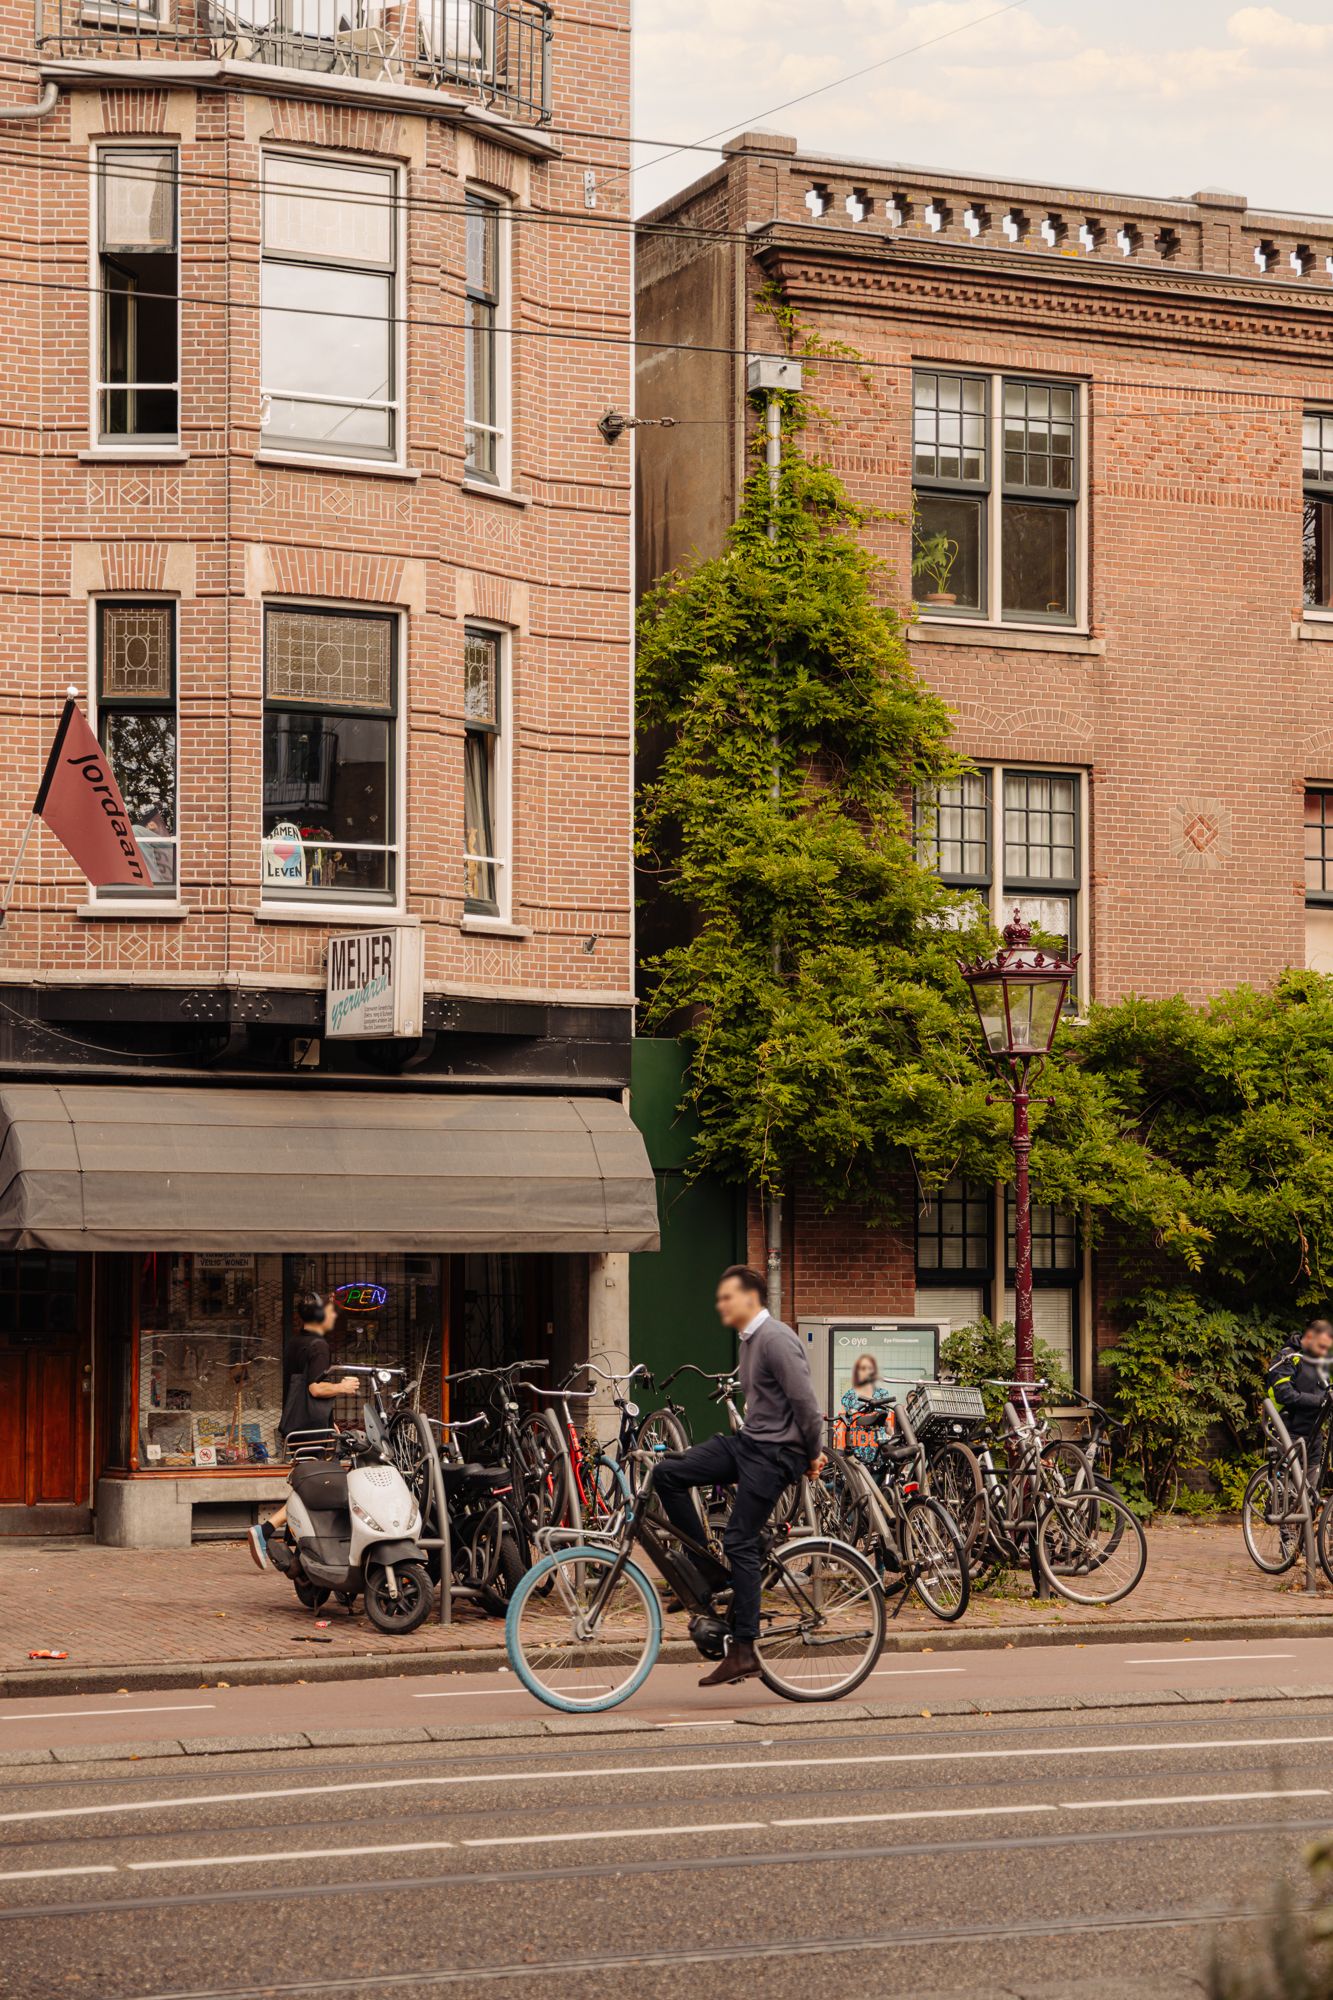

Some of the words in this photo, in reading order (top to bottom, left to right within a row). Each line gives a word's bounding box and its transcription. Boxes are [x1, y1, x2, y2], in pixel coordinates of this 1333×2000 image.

[66, 753, 144, 879] Jordaan
[267, 860, 303, 877] LEVEN
[331, 935, 392, 991] MEIJER
[334, 1288, 387, 1305] OPEN
[851, 1337, 868, 1348] eye
